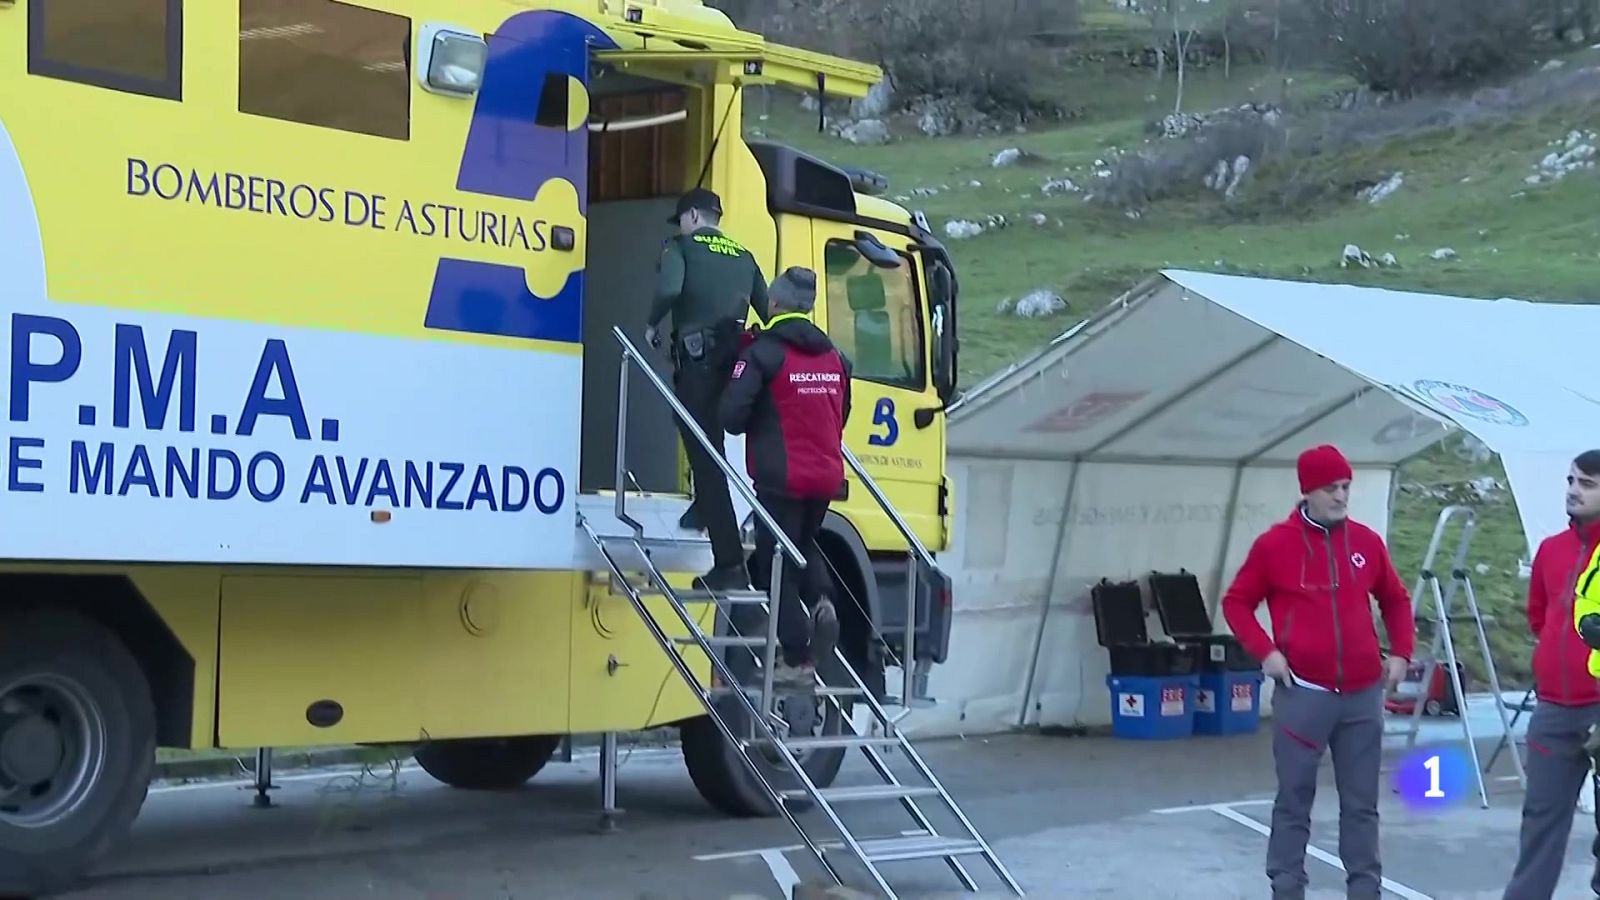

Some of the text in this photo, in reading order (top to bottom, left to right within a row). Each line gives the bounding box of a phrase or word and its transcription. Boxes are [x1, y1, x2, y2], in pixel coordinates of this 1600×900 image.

[126, 157, 547, 252] BOMBEROS DE ASTURIAS
[708, 244, 740, 257] CIVIL
[9, 312, 340, 442] P.M.A.
[789, 372, 841, 383] RESCATADOR
[0, 436, 565, 515] E MANDO AVANZADO
